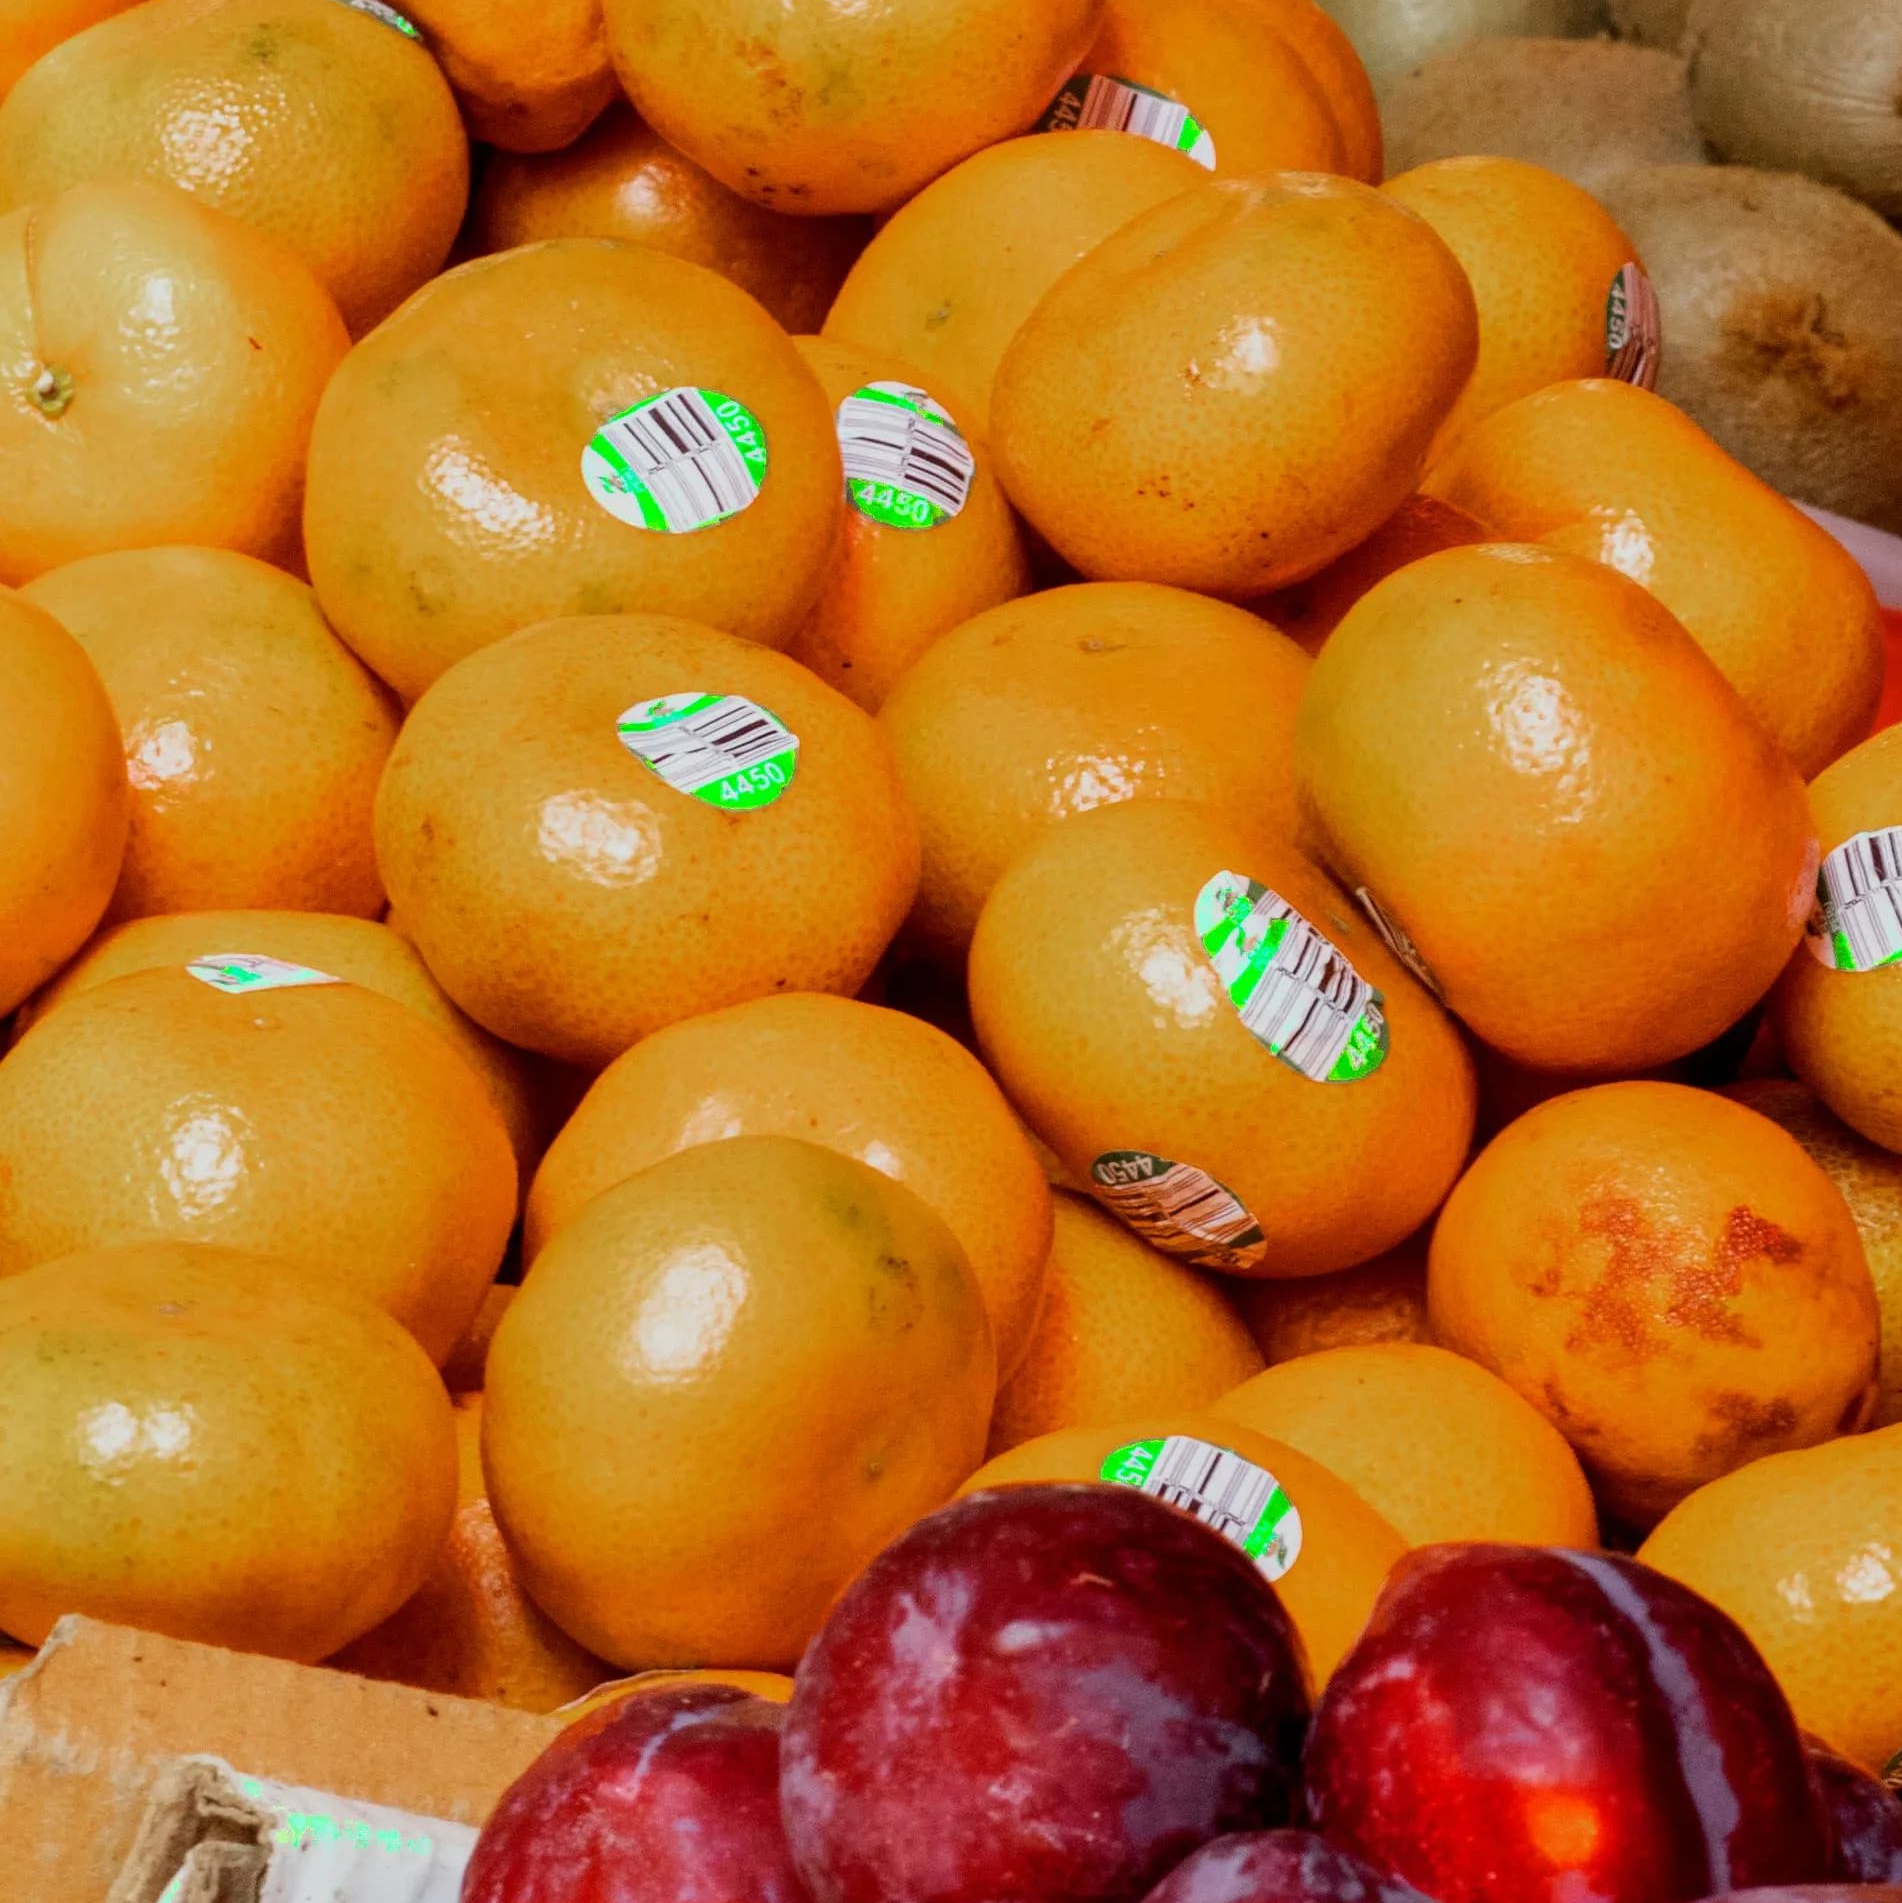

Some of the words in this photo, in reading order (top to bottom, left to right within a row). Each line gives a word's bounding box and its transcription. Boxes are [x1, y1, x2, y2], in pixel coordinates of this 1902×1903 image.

[1607, 283, 1627, 350] 4450
[716, 401, 766, 463] 4450
[858, 483, 930, 523] 4450
[719, 762, 786, 802] 4450
[1348, 1001, 1384, 1071] 4450
[1097, 1154, 1153, 1185] 4450
[1115, 1446, 1153, 1486] 445
